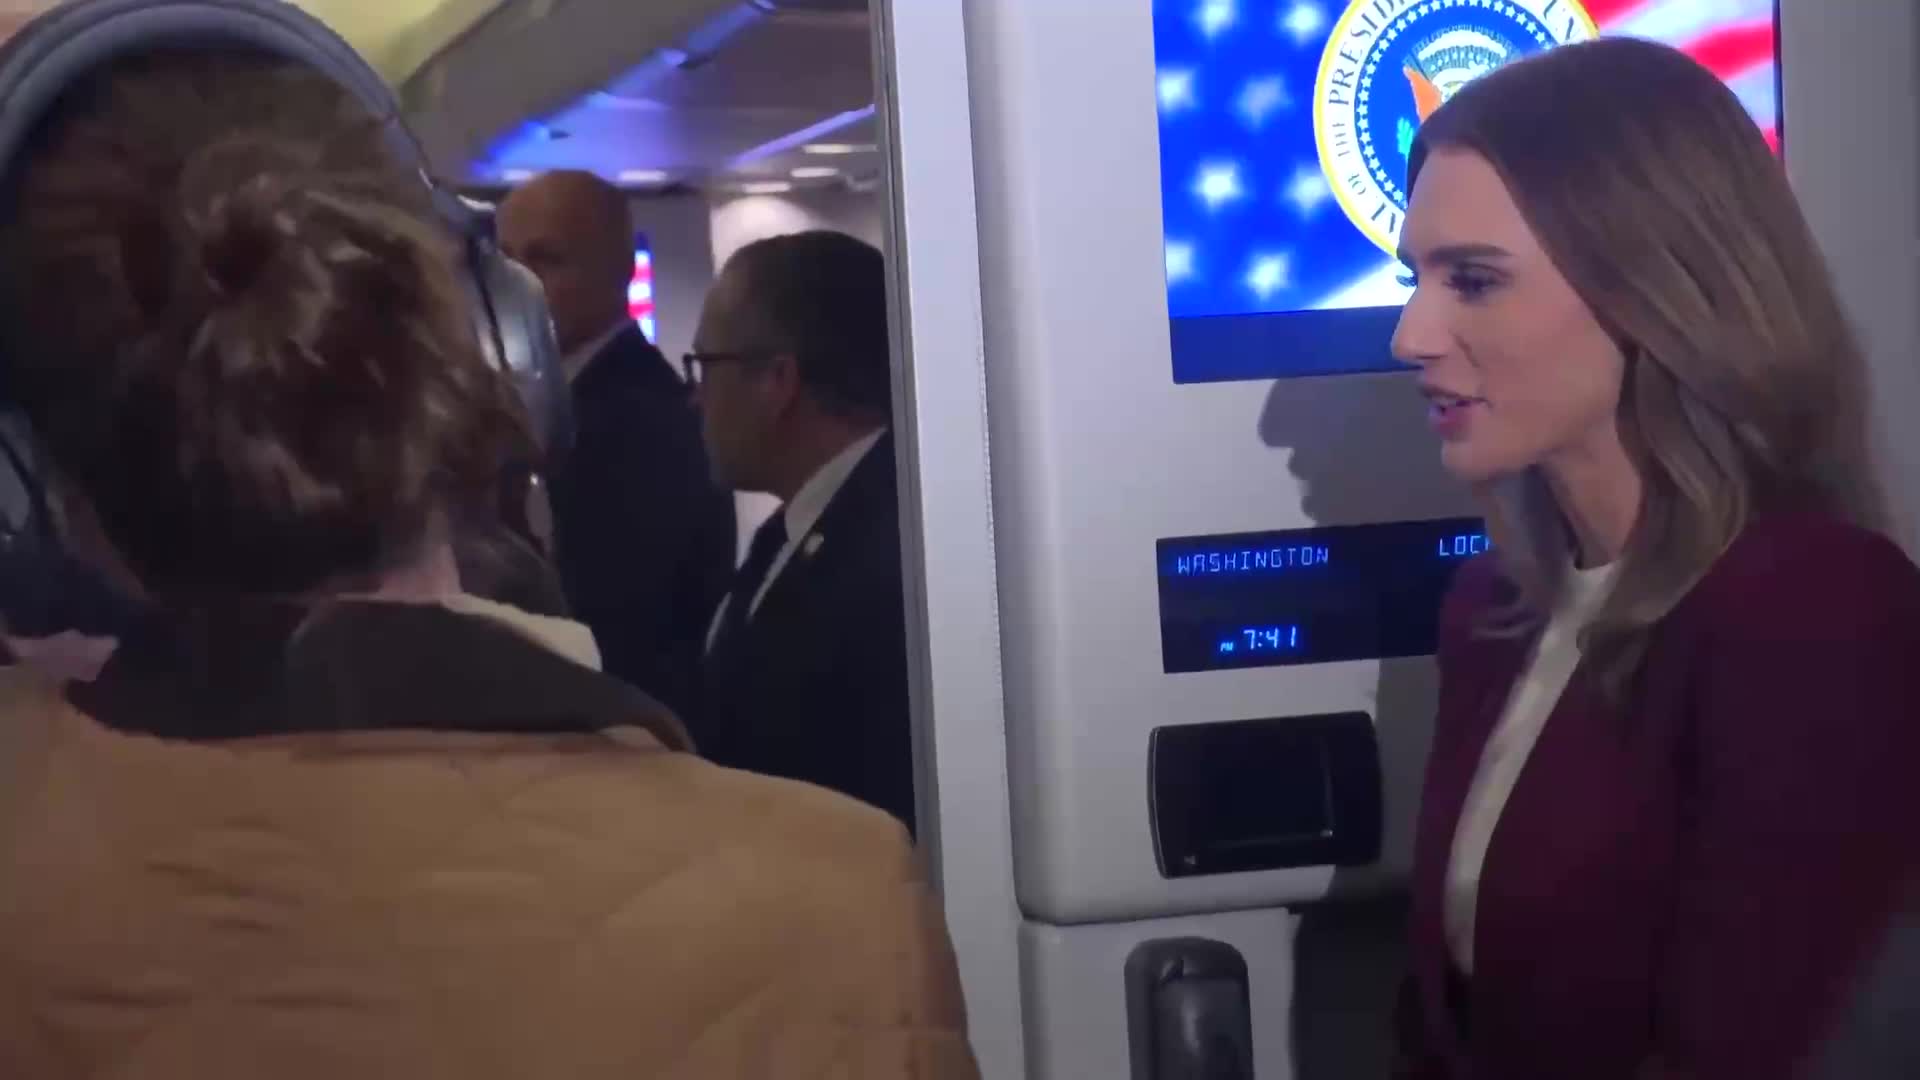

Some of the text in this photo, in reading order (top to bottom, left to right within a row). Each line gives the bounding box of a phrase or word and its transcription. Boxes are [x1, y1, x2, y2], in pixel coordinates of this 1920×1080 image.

[1327, 0, 1406, 105] PRESID
[1177, 546, 1329, 577] WASHINGTON
[1243, 625, 1297, 651] 7:41
